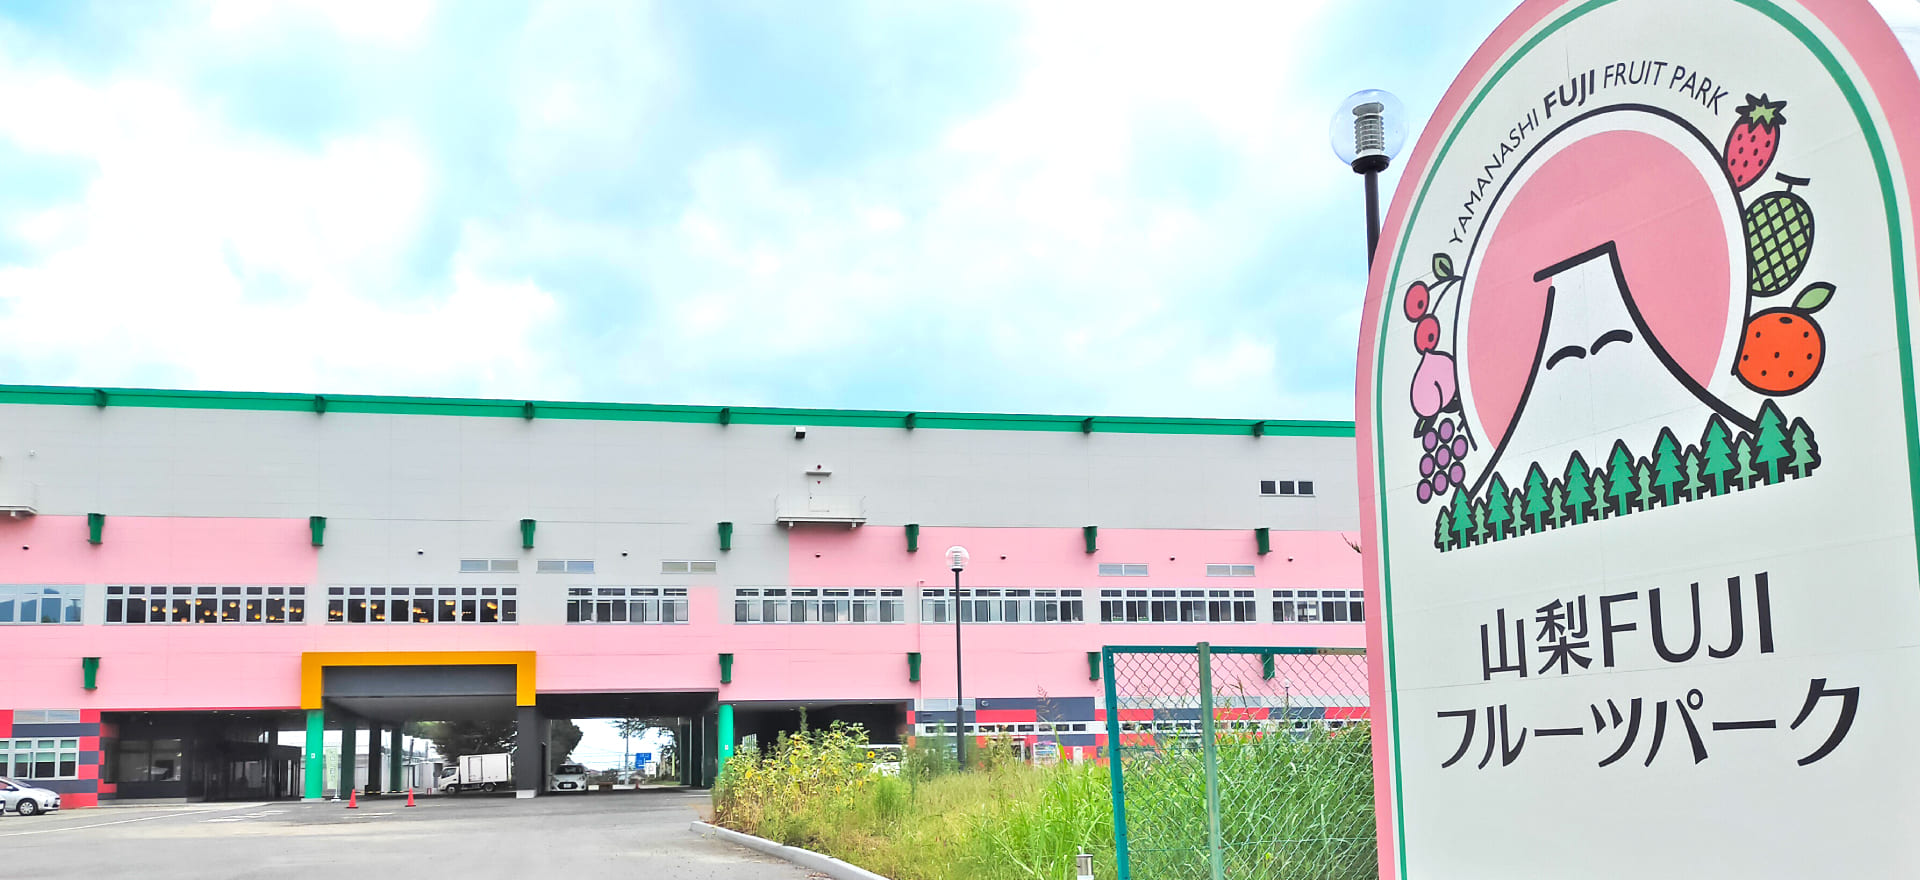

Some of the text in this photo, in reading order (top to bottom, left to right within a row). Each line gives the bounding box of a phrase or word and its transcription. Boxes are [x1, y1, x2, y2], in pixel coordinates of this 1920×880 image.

[1449, 60, 1729, 244] YAMANASHI FUJI FRUIT PARK
[1480, 571, 1775, 681] 山梨FUJI
[1437, 677, 1860, 770] フルーツパーク
